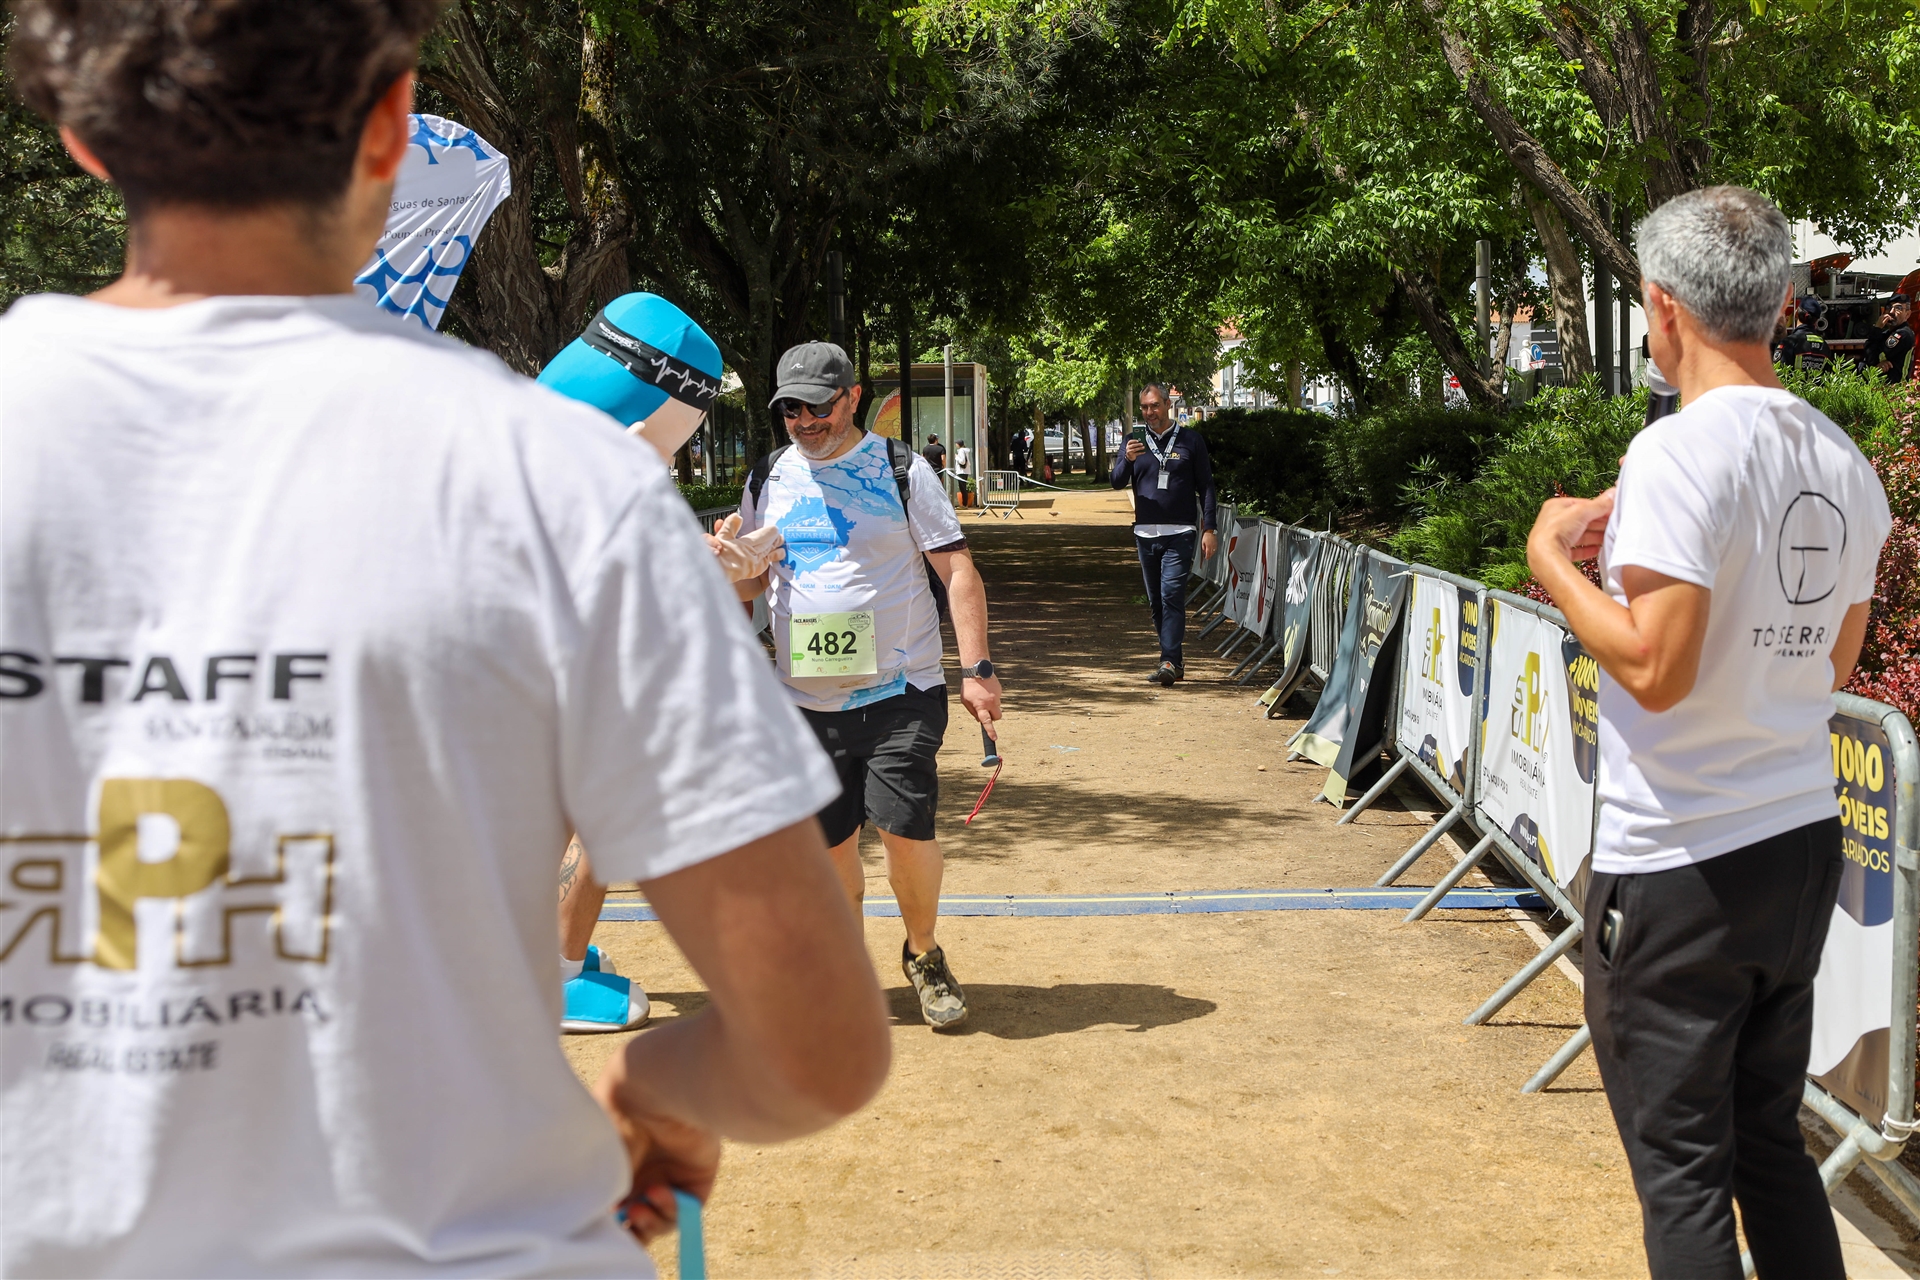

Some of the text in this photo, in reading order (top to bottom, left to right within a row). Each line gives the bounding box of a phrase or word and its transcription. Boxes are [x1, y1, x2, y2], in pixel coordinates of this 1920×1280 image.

[421, 199, 434, 207] de
[807, 631, 857, 655] 482
[1753, 624, 1830, 647] TÓ SERR
[0, 652, 329, 703] STAFF
[1838, 786, 1890, 841] ÓVEIS
[1841, 836, 1891, 874] ARIADOS
